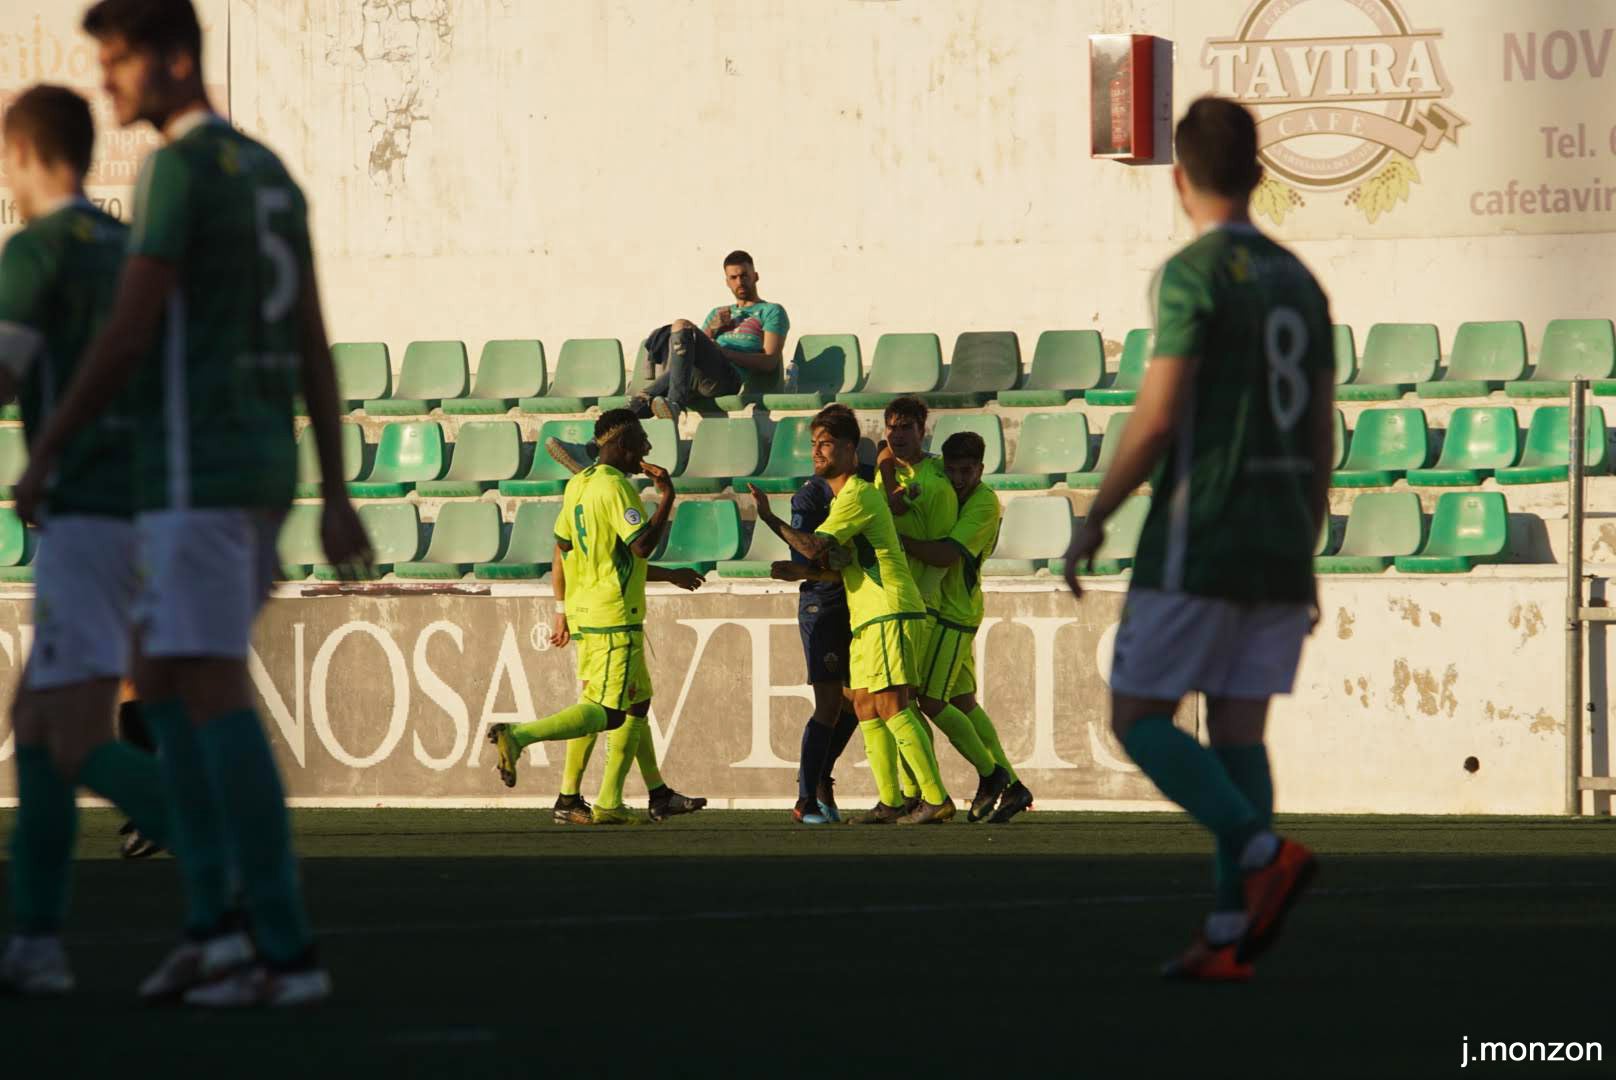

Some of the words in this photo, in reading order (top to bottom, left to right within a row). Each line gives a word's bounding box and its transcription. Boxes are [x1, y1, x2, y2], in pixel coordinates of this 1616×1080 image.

[1204, 41, 1444, 99] TAVIRA
[1503, 28, 1616, 81] NOV
[1540, 123, 1603, 159] Tel.
[256, 187, 299, 323] 5
[1264, 306, 1311, 432] 8
